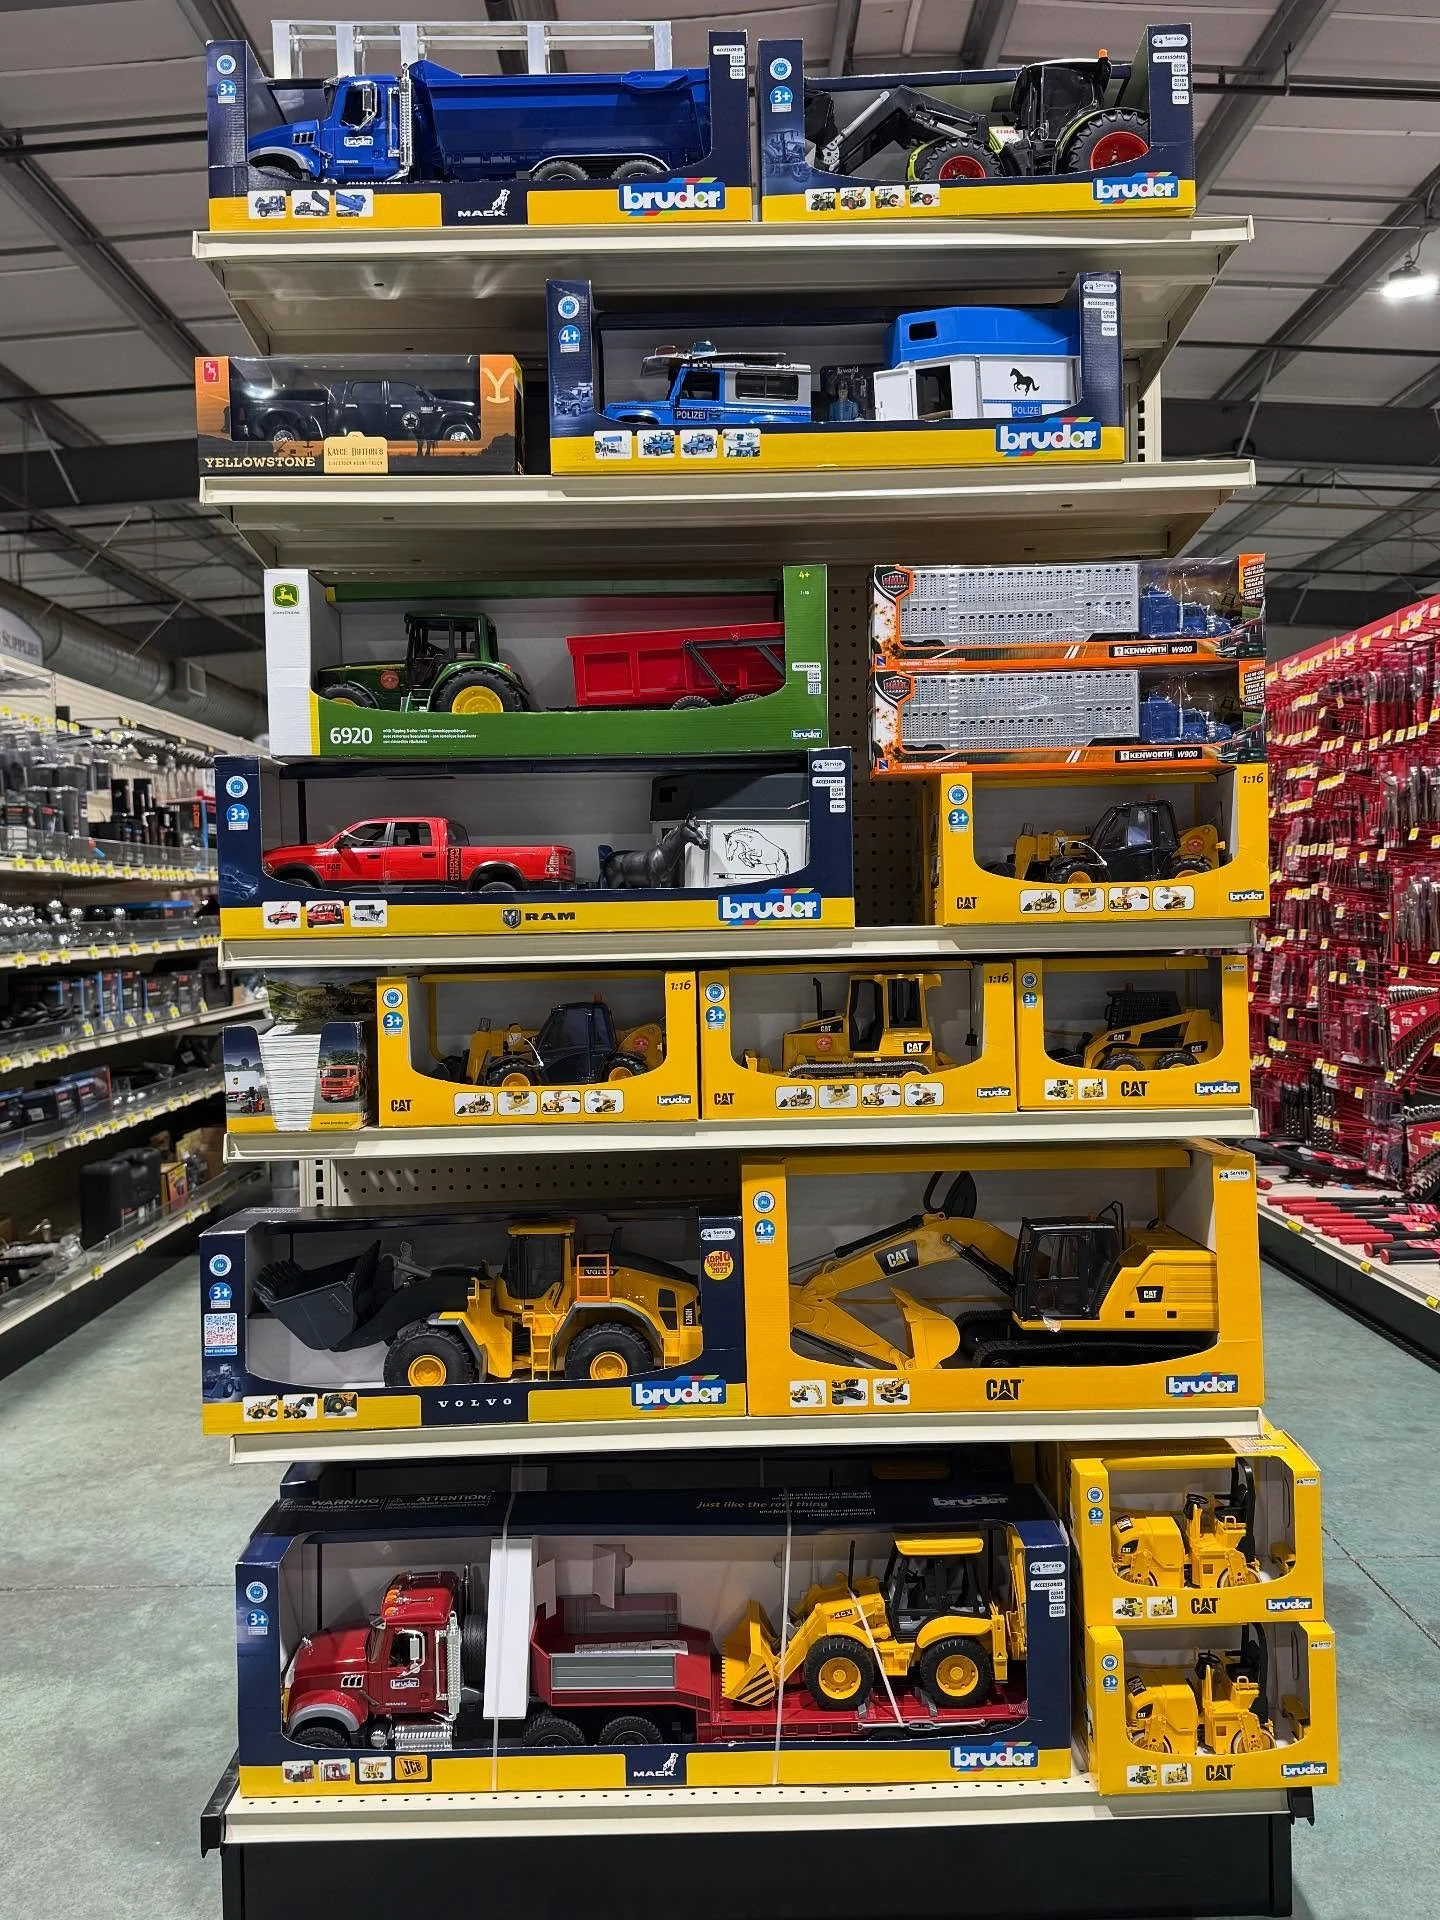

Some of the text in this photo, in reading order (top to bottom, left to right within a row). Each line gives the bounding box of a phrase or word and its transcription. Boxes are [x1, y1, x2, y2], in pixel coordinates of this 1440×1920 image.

[220, 83, 235, 96] 3+
[774, 90, 791, 103] 3+
[346, 137, 371, 145] bruder
[1096, 177, 1175, 199] bruder
[623, 184, 720, 210] bruder
[457, 209, 506, 217] MACK
[560, 329, 579, 343] 4+
[481, 367, 515, 404] Y
[676, 410, 706, 420] POLIZEI
[1012, 405, 1041, 416] POLIZEI
[1000, 425, 1097, 450] bruder
[205, 457, 316, 468] YELLOWSTONE
[799, 570, 810, 579] 4+
[1124, 645, 1193, 655] KENWORTH W900
[329, 727, 373, 745] 6920
[792, 730, 821, 738] bruder
[1130, 750, 1198, 760] KENWORTH W900
[1242, 772, 1264, 784] 1:16
[230, 807, 248, 821] 3+
[952, 811, 968, 824] 3+
[1230, 891, 1264, 901] bruder
[723, 896, 817, 919] bruder
[956, 896, 977, 909] CAT
[525, 911, 576, 921] RAM
[988, 972, 1009, 984] 1:16
[670, 980, 691, 991] 1:16
[1024, 994, 1037, 1003] 3+
[386, 1014, 402, 1027] 3+
[709, 1009, 725, 1021] 3+
[906, 1042, 924, 1053] CAT
[1191, 1045, 1202, 1053] CAT
[977, 1088, 1010, 1097] bruder
[1120, 1080, 1148, 1097] CAT
[1196, 1082, 1239, 1093] bruder
[658, 1095, 691, 1104] bruder
[713, 1092, 735, 1105] CAT
[390, 1099, 412, 1112] CAT
[756, 1222, 774, 1234] 4+
[886, 1248, 910, 1268] CAT
[213, 1286, 231, 1300] 3+
[1143, 1290, 1158, 1299] CAT
[985, 1378, 1022, 1401] CAT
[1167, 1377, 1237, 1395] bruder
[635, 1383, 722, 1405] bruder
[438, 1398, 512, 1408] VOLVO
[311, 1498, 379, 1506] WARNING
[416, 1494, 486, 1502] ATTENTION
[796, 1500, 828, 1508] thing
[932, 1496, 1008, 1506] bruder
[1090, 1509, 1104, 1519] 3+
[1190, 1597, 1218, 1615] CAT
[1267, 1598, 1311, 1610] bruder
[250, 1613, 267, 1626] 3+
[834, 1609, 853, 1618] 4CX
[392, 1680, 417, 1688] bruder
[1104, 1677, 1119, 1687] 3+
[954, 1748, 1035, 1767] bruder
[403, 1758, 423, 1774] JCB
[1282, 1764, 1326, 1776] bruder
[1205, 1764, 1233, 1782] CAT
